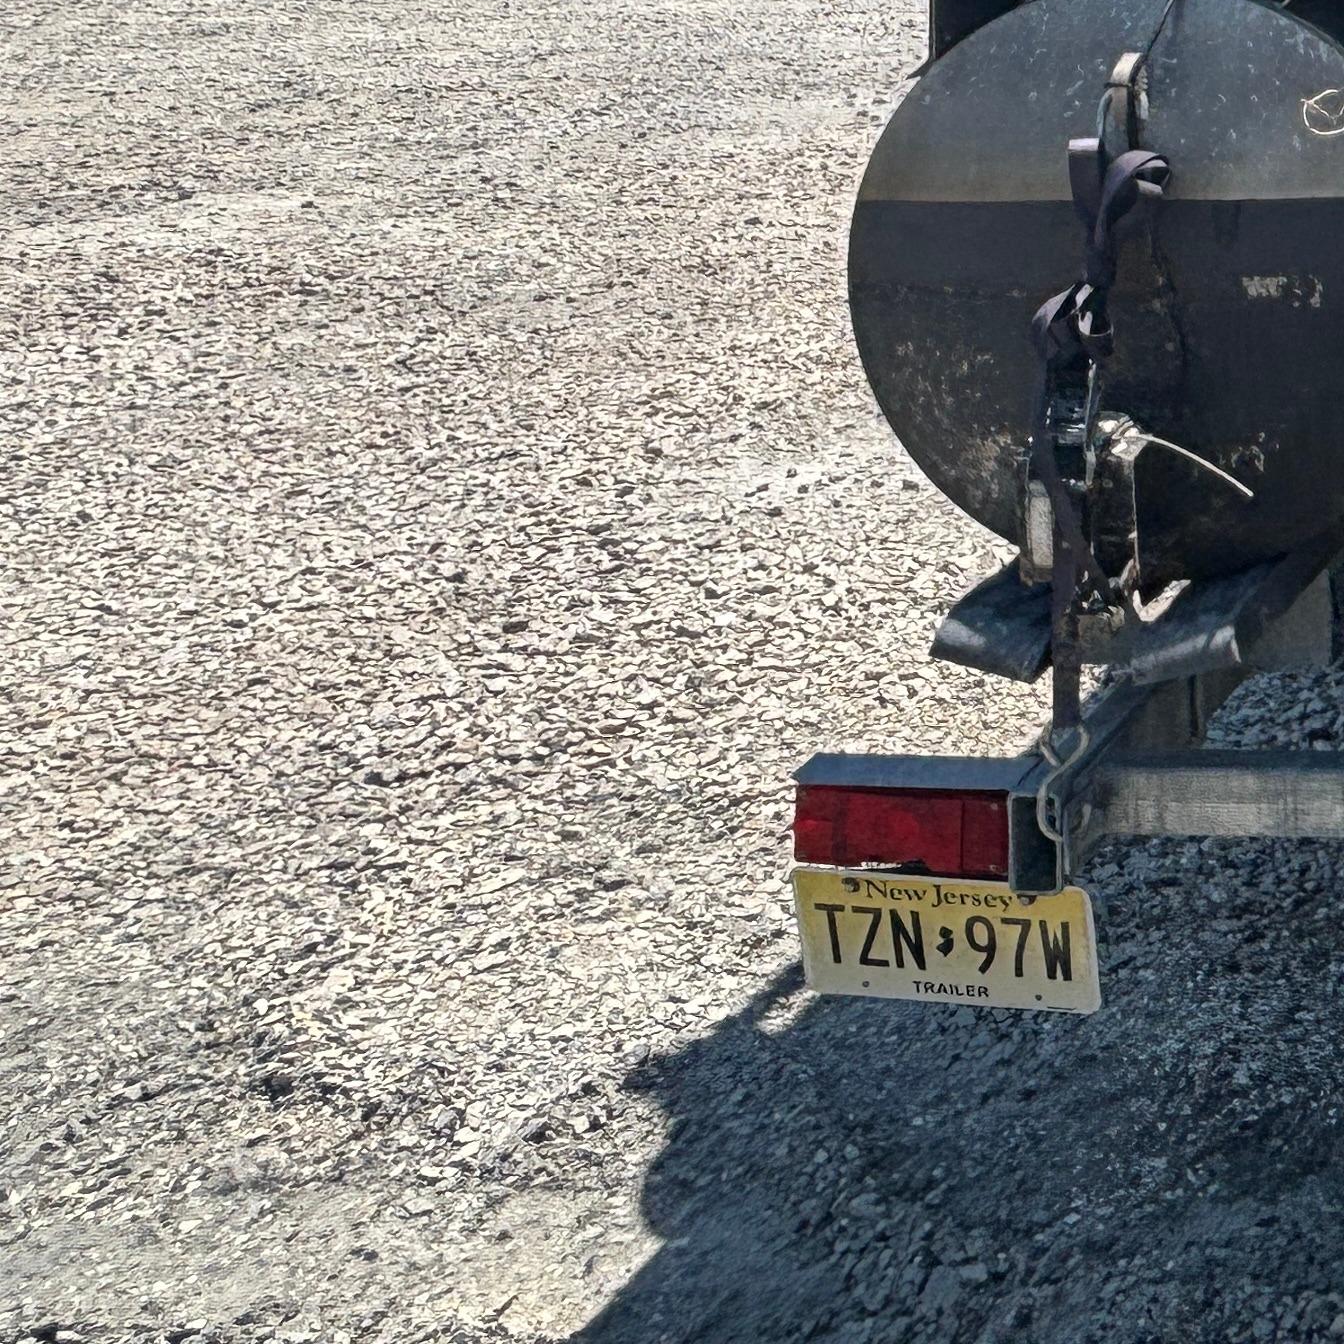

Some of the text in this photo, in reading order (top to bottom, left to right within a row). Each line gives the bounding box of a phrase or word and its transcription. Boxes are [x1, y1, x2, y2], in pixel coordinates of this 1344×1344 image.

[865, 879, 1013, 912] New Jersey
[911, 980, 990, 999] TRAILER
